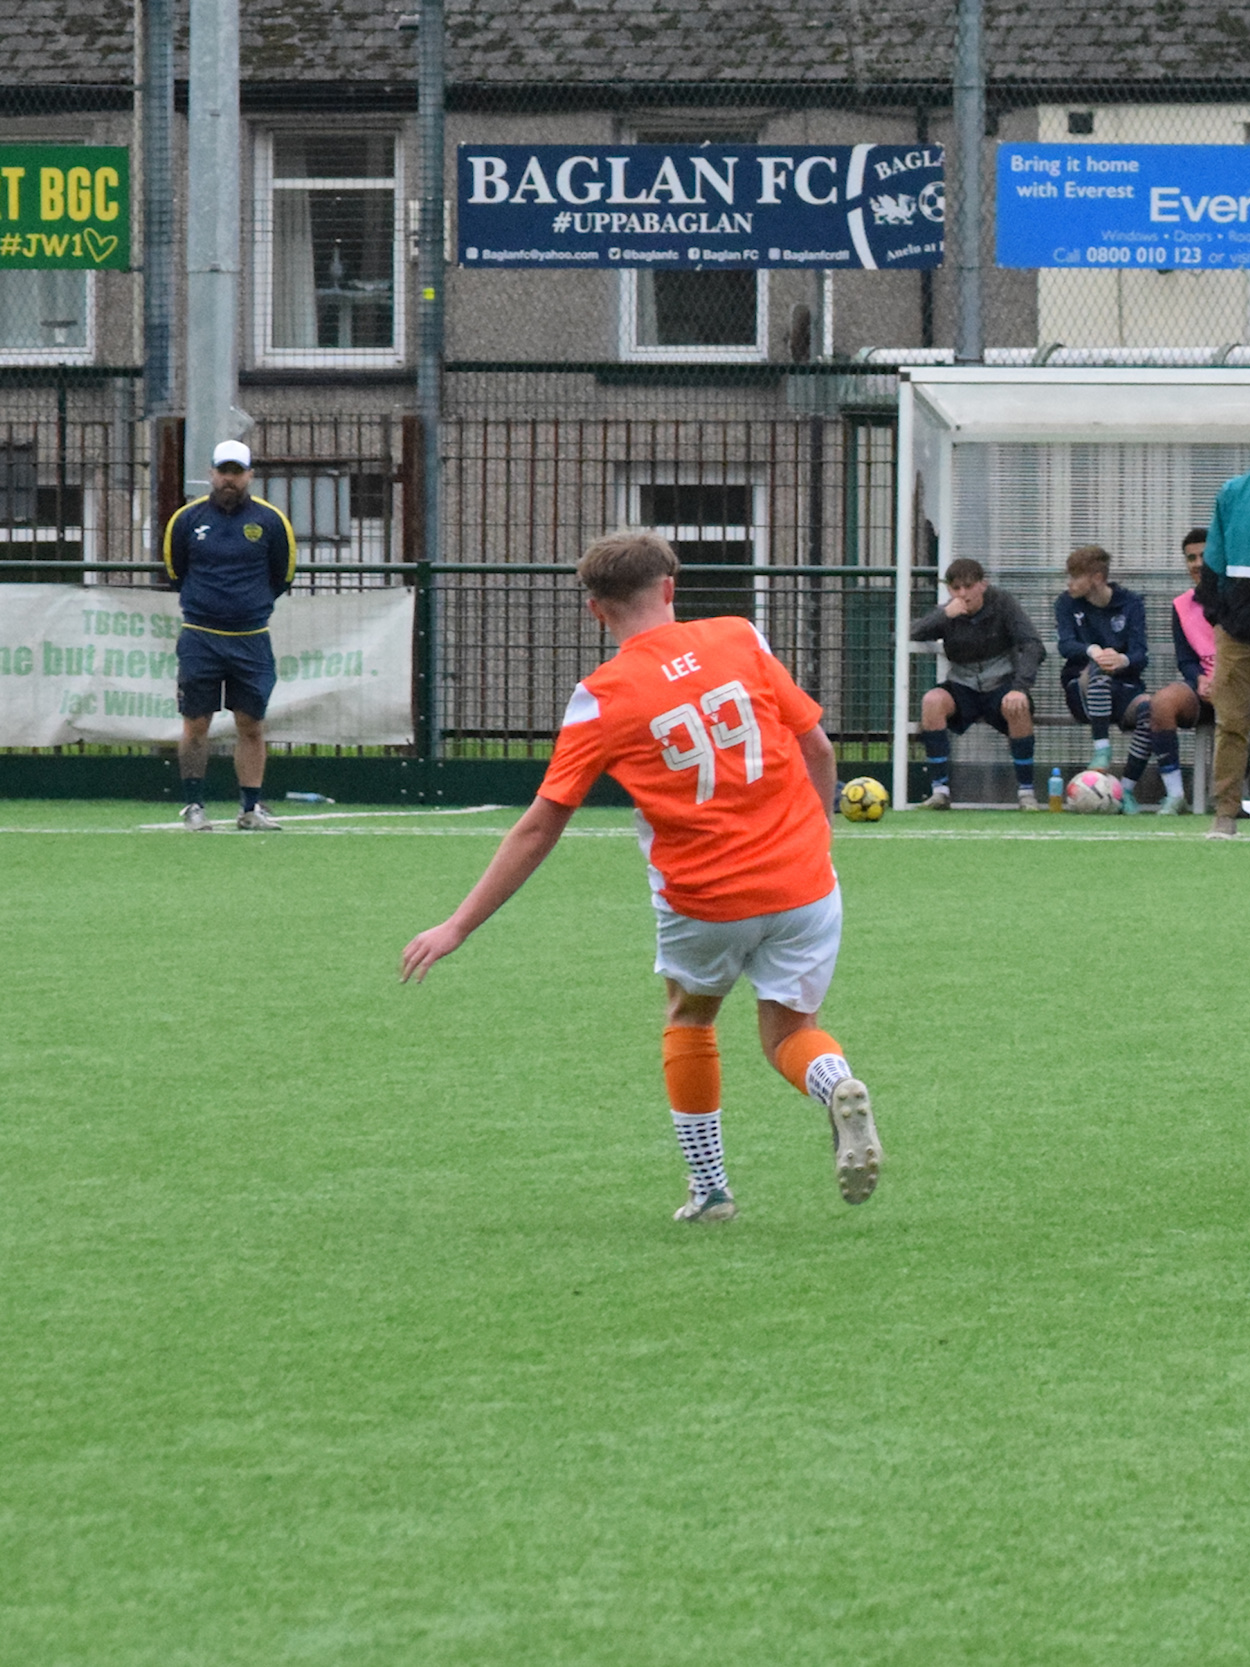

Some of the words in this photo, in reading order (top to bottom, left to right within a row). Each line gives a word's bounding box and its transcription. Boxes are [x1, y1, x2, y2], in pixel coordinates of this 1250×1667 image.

[1011, 155, 1061, 176] Bring
[1067, 156, 1081, 172] it
[1086, 156, 1140, 172] home
[0, 166, 26, 221] T
[40, 166, 119, 221] BGC
[467, 156, 739, 204] BAGLAN
[756, 156, 838, 205] FC
[1016, 182, 1058, 198] with
[1065, 181, 1135, 199] Everest
[552, 211, 754, 234] #UPPABAGLAN
[0, 233, 84, 257] #JW1
[1101, 230, 1158, 242] Windows
[1174, 230, 1212, 242] Doors
[703, 249, 742, 262] Baglan
[743, 249, 760, 260] FC
[1053, 247, 1081, 263] Call
[1086, 246, 1131, 263] 0800
[1136, 247, 1167, 263] 010
[1174, 247, 1202, 263] 123
[1208, 252, 1225, 264] or
[82, 609, 145, 637] TBGC
[42, 640, 96, 676] but
[103, 648, 180, 679] neve
[278, 650, 363, 682] otten
[661, 651, 701, 682] LEE
[103, 690, 183, 719] Willia
[650, 680, 763, 805] 99
